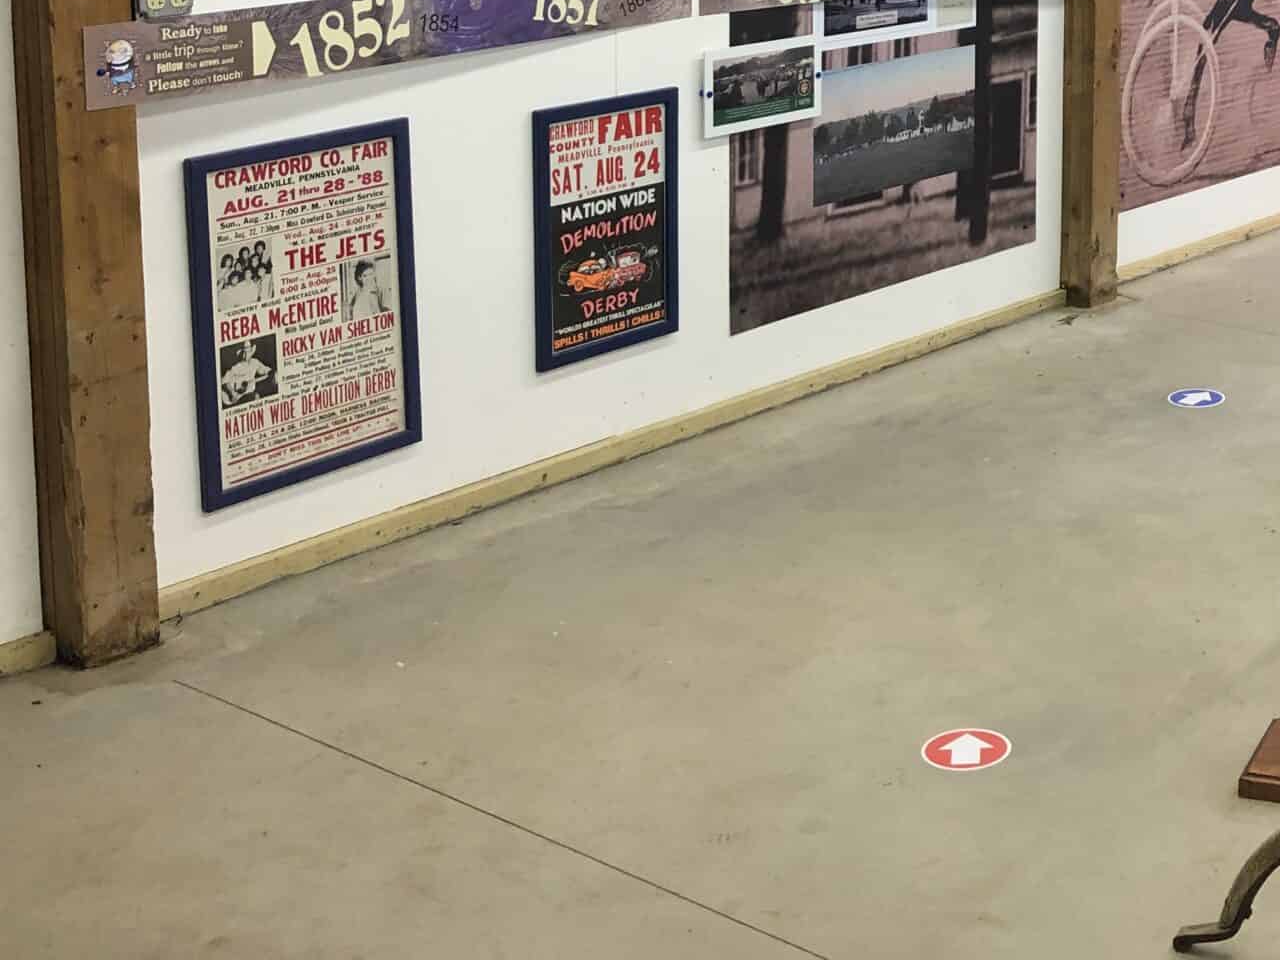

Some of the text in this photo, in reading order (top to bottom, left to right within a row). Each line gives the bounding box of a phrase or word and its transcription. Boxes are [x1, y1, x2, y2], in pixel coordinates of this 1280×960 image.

[161, 24, 202, 40] Ready
[203, 27, 212, 35] to
[420, 13, 460, 33] 1854
[152, 50, 173, 60] little
[174, 43, 195, 58] trip
[148, 77, 191, 93] Please
[192, 76, 212, 87] don't
[549, 118, 594, 141] CRAWFORD
[597, 106, 663, 145] FAIR
[549, 136, 594, 153] COUNTY
[558, 147, 601, 163] MEADVILLE
[214, 140, 388, 189] CRAWFORD CO. FAIR
[244, 164, 360, 194] MEADVILLE, PENNSYLVANIA
[551, 163, 588, 196] SAT.
[596, 156, 628, 187] AUG.
[634, 147, 660, 178] 24
[223, 170, 384, 215] AUG. 21 thru 28 '88
[561, 197, 617, 224] NATION
[619, 188, 656, 208] WIDE
[285, 229, 386, 270] THE JETS
[560, 211, 657, 255] DEMOLITION
[220, 316, 260, 343] REBA
[268, 292, 338, 330] McENTIRE
[581, 288, 639, 318] DERBY
[282, 333, 316, 357] RICKY
[320, 325, 342, 346] VAN
[347, 311, 395, 339] SHELTON
[553, 331, 589, 349] SPILLS!
[225, 409, 265, 440] NATION
[270, 400, 295, 424] WIDE
[301, 383, 360, 415] DEMOLITION
[365, 368, 397, 395] DERBY
